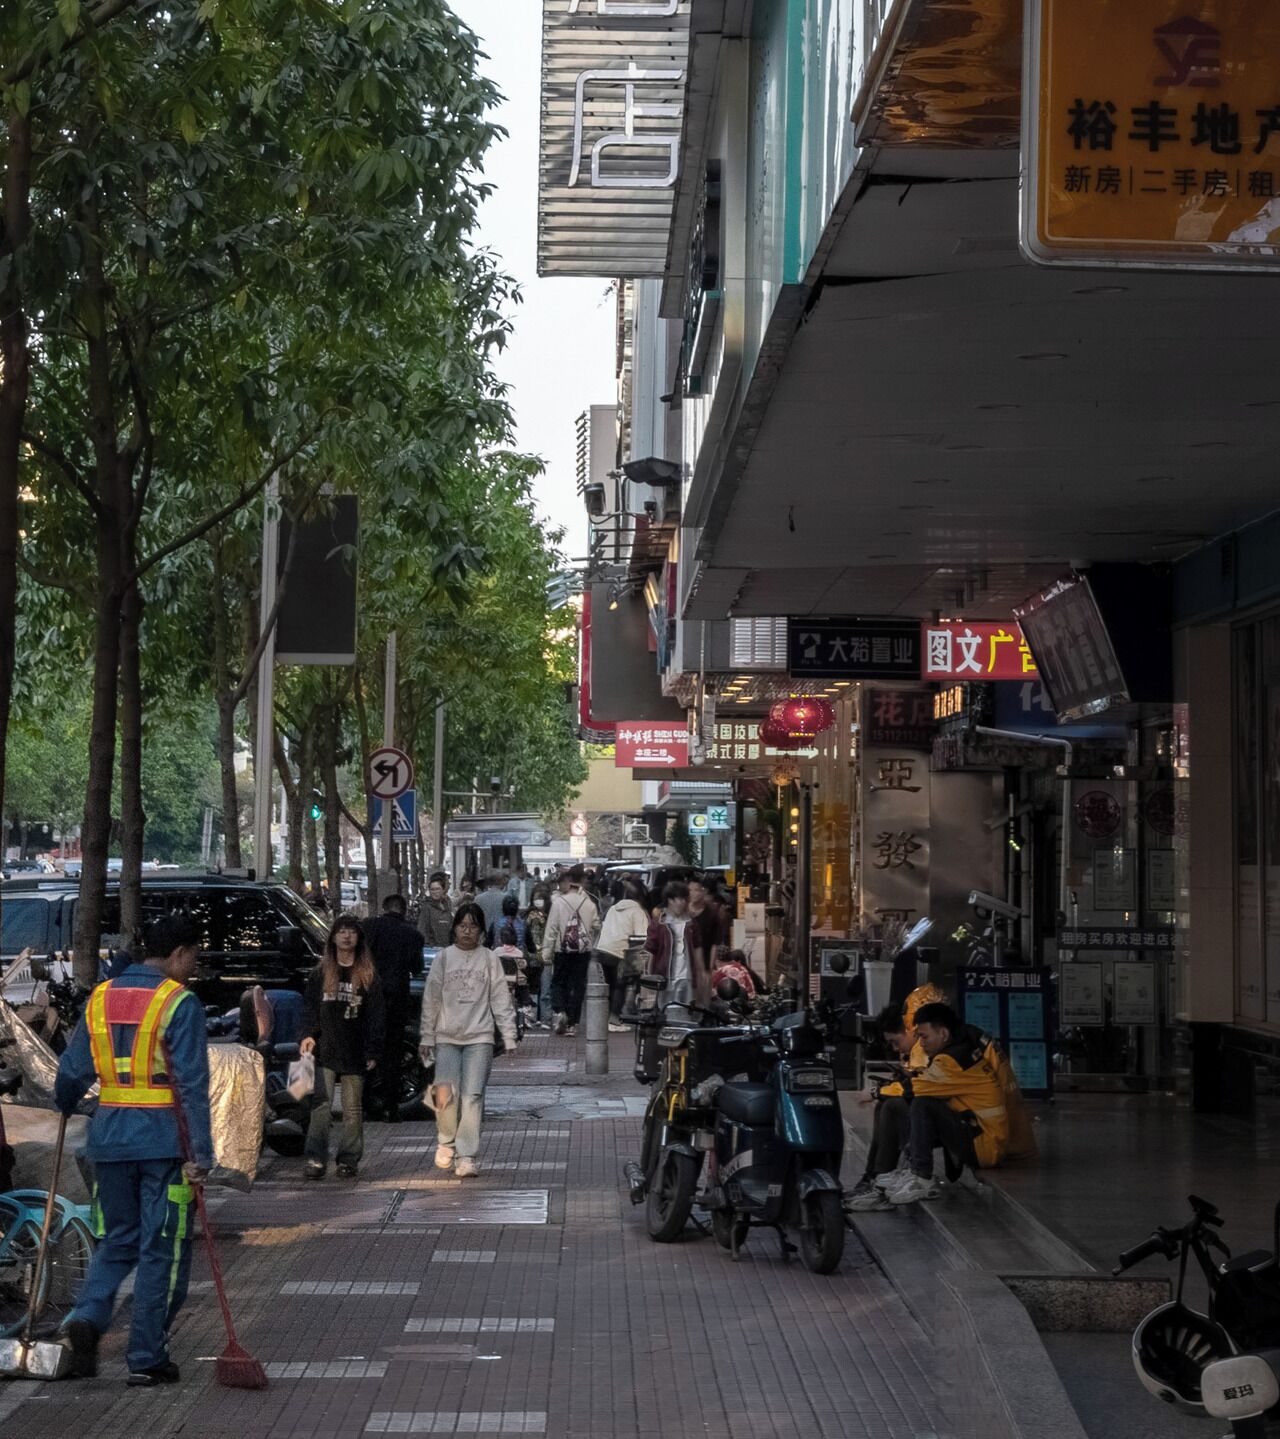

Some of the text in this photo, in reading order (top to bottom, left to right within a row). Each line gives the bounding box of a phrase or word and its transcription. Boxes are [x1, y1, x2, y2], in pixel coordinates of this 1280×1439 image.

[827, 636, 914, 663] 大裕置业
[1223, 1384, 1254, 1401] 爱玛
